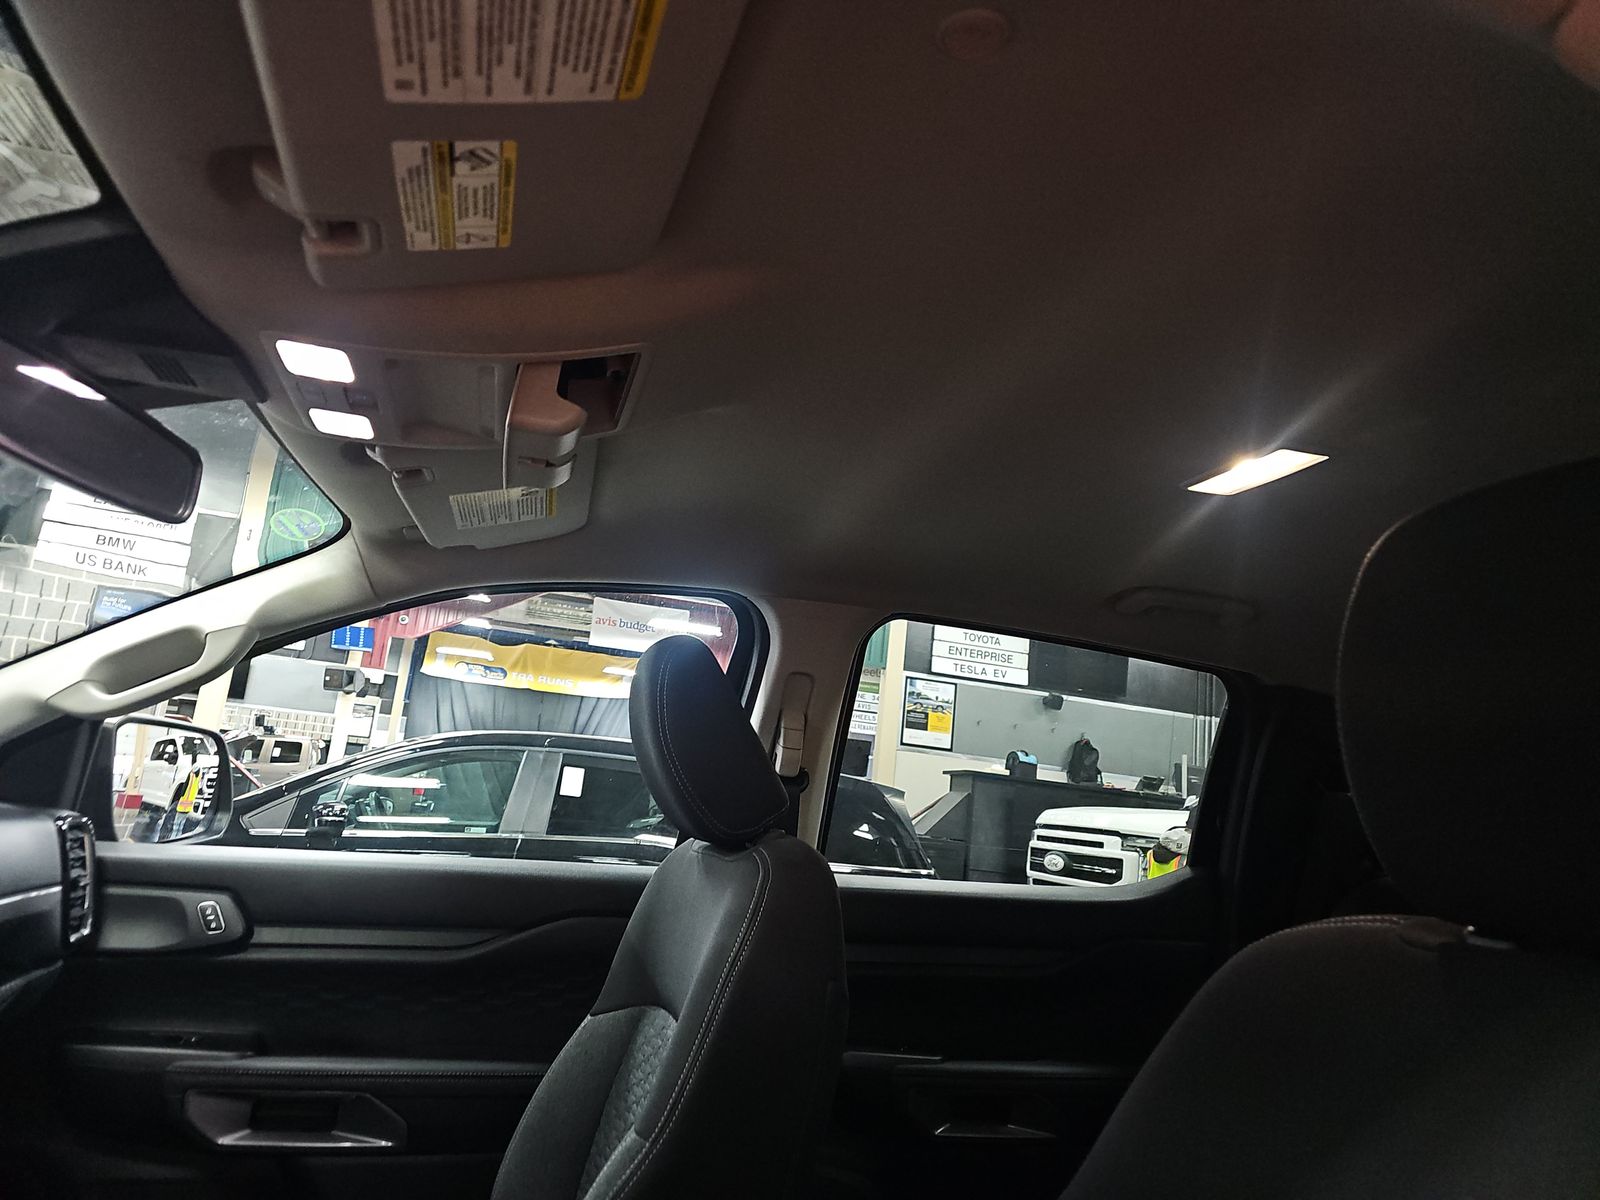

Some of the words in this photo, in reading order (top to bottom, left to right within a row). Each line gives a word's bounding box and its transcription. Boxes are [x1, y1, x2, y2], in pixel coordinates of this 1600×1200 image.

[95, 534, 137, 551] BMW
[75, 551, 97, 567] US
[102, 558, 148, 577] BANK
[595, 616, 617, 627] avis
[963, 631, 1001, 646] TOYOTA
[948, 645, 1014, 664] ENTERPRISE
[953, 662, 988, 677] TESLA
[993, 669, 1008, 679] EV
